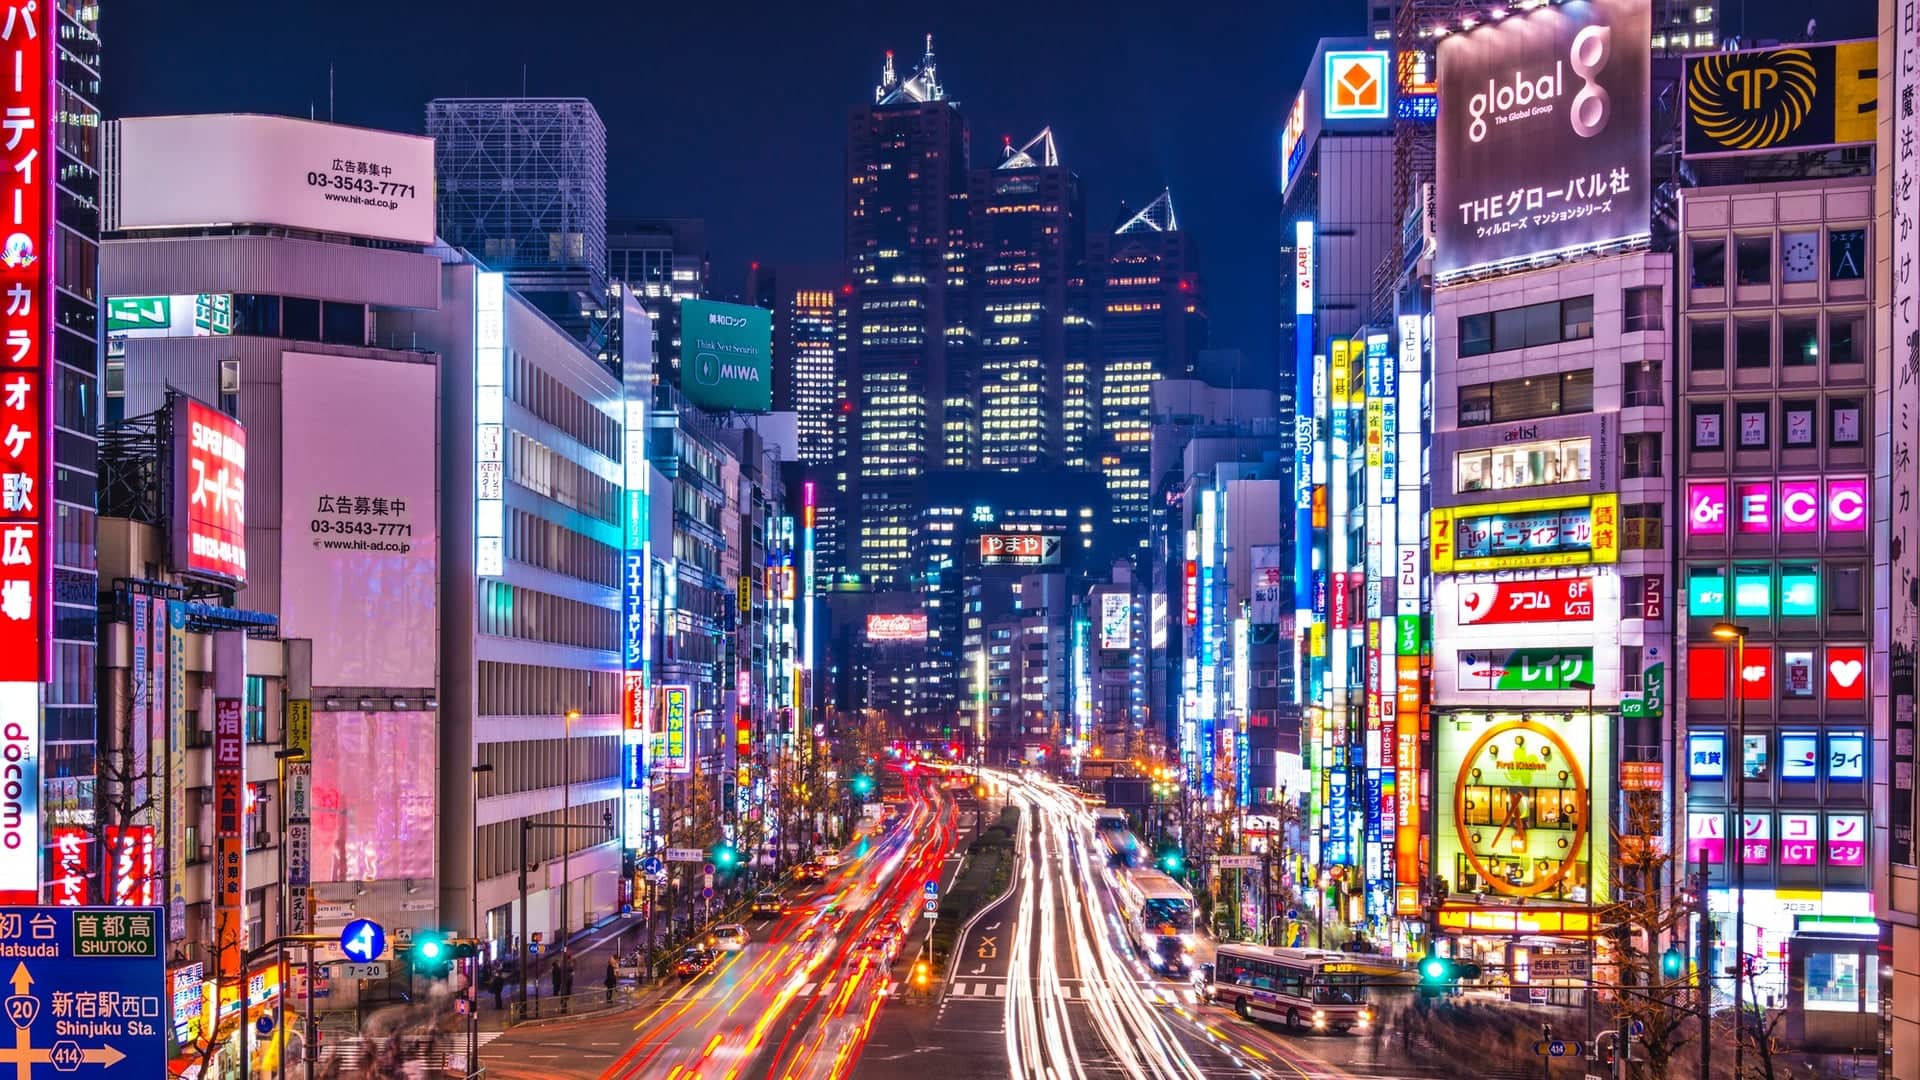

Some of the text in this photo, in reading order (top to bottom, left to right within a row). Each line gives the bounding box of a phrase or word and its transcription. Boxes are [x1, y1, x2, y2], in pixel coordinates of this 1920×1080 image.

[1, 0, 38, 225] パーティー
[1469, 61, 1562, 142] global
[1494, 104, 1553, 126] The Global Group
[332, 159, 392, 178] 広告募集中
[307, 172, 416, 199] 03-3543-7771
[1459, 167, 1630, 225] THEグローバル社
[325, 193, 398, 210] www.hit-ad.co.jp
[1477, 200, 1612, 238] ウィルローズ マンションシリーズ
[1298, 247, 1307, 276] LABI
[709, 313, 747, 328] 美和ロック
[696, 339, 759, 356] Think Next Security
[721, 364, 760, 382] MIWA
[1504, 425, 1537, 442] artist
[1, 283, 33, 620] カラオケ歌広場
[317, 494, 406, 517] 広告募集中
[1694, 496, 1724, 523] 6F
[311, 520, 411, 536] 03-3543-7771
[1492, 523, 1590, 547] エーアイアール
[1594, 506, 1614, 549] 賃貸
[324, 540, 410, 554] www.hit-ad.co.jp
[987, 536, 1039, 553] やまや
[1434, 520, 1449, 560] 7F
[1403, 551, 1415, 585] アコム
[1510, 591, 1551, 610] アコム
[1568, 582, 1588, 599] 6F
[1647, 578, 1660, 617] アコム
[1577, 605, 1591, 615] 入口
[1404, 620, 1414, 650] レイク
[1521, 655, 1583, 682] レイク
[1648, 673, 1660, 709] レイク
[1622, 703, 1641, 713] レイク
[218, 710, 240, 762] 指圧
[1693, 751, 1721, 766] 賃貸
[1831, 752, 1862, 768] タイ
[4, 722, 29, 849] docomo
[1399, 734, 1410, 826] First Kitchen
[1332, 786, 1346, 837] ソフマップ
[1368, 780, 1379, 819] ソフマップ
[1784, 845, 1815, 859] ICT
[1830, 847, 1861, 860] ビジ
[227, 852, 239, 894] 吉野家
[0, 913, 57, 939] 初台
[77, 915, 151, 938] 首都高
[81, 941, 148, 953] SHUTOKO
[12, 1001, 32, 1018] 20
[51, 991, 159, 1018] 新宿駅西口
[56, 1020, 157, 1037] Shinjuku Sta.
[54, 1050, 78, 1063] 414
